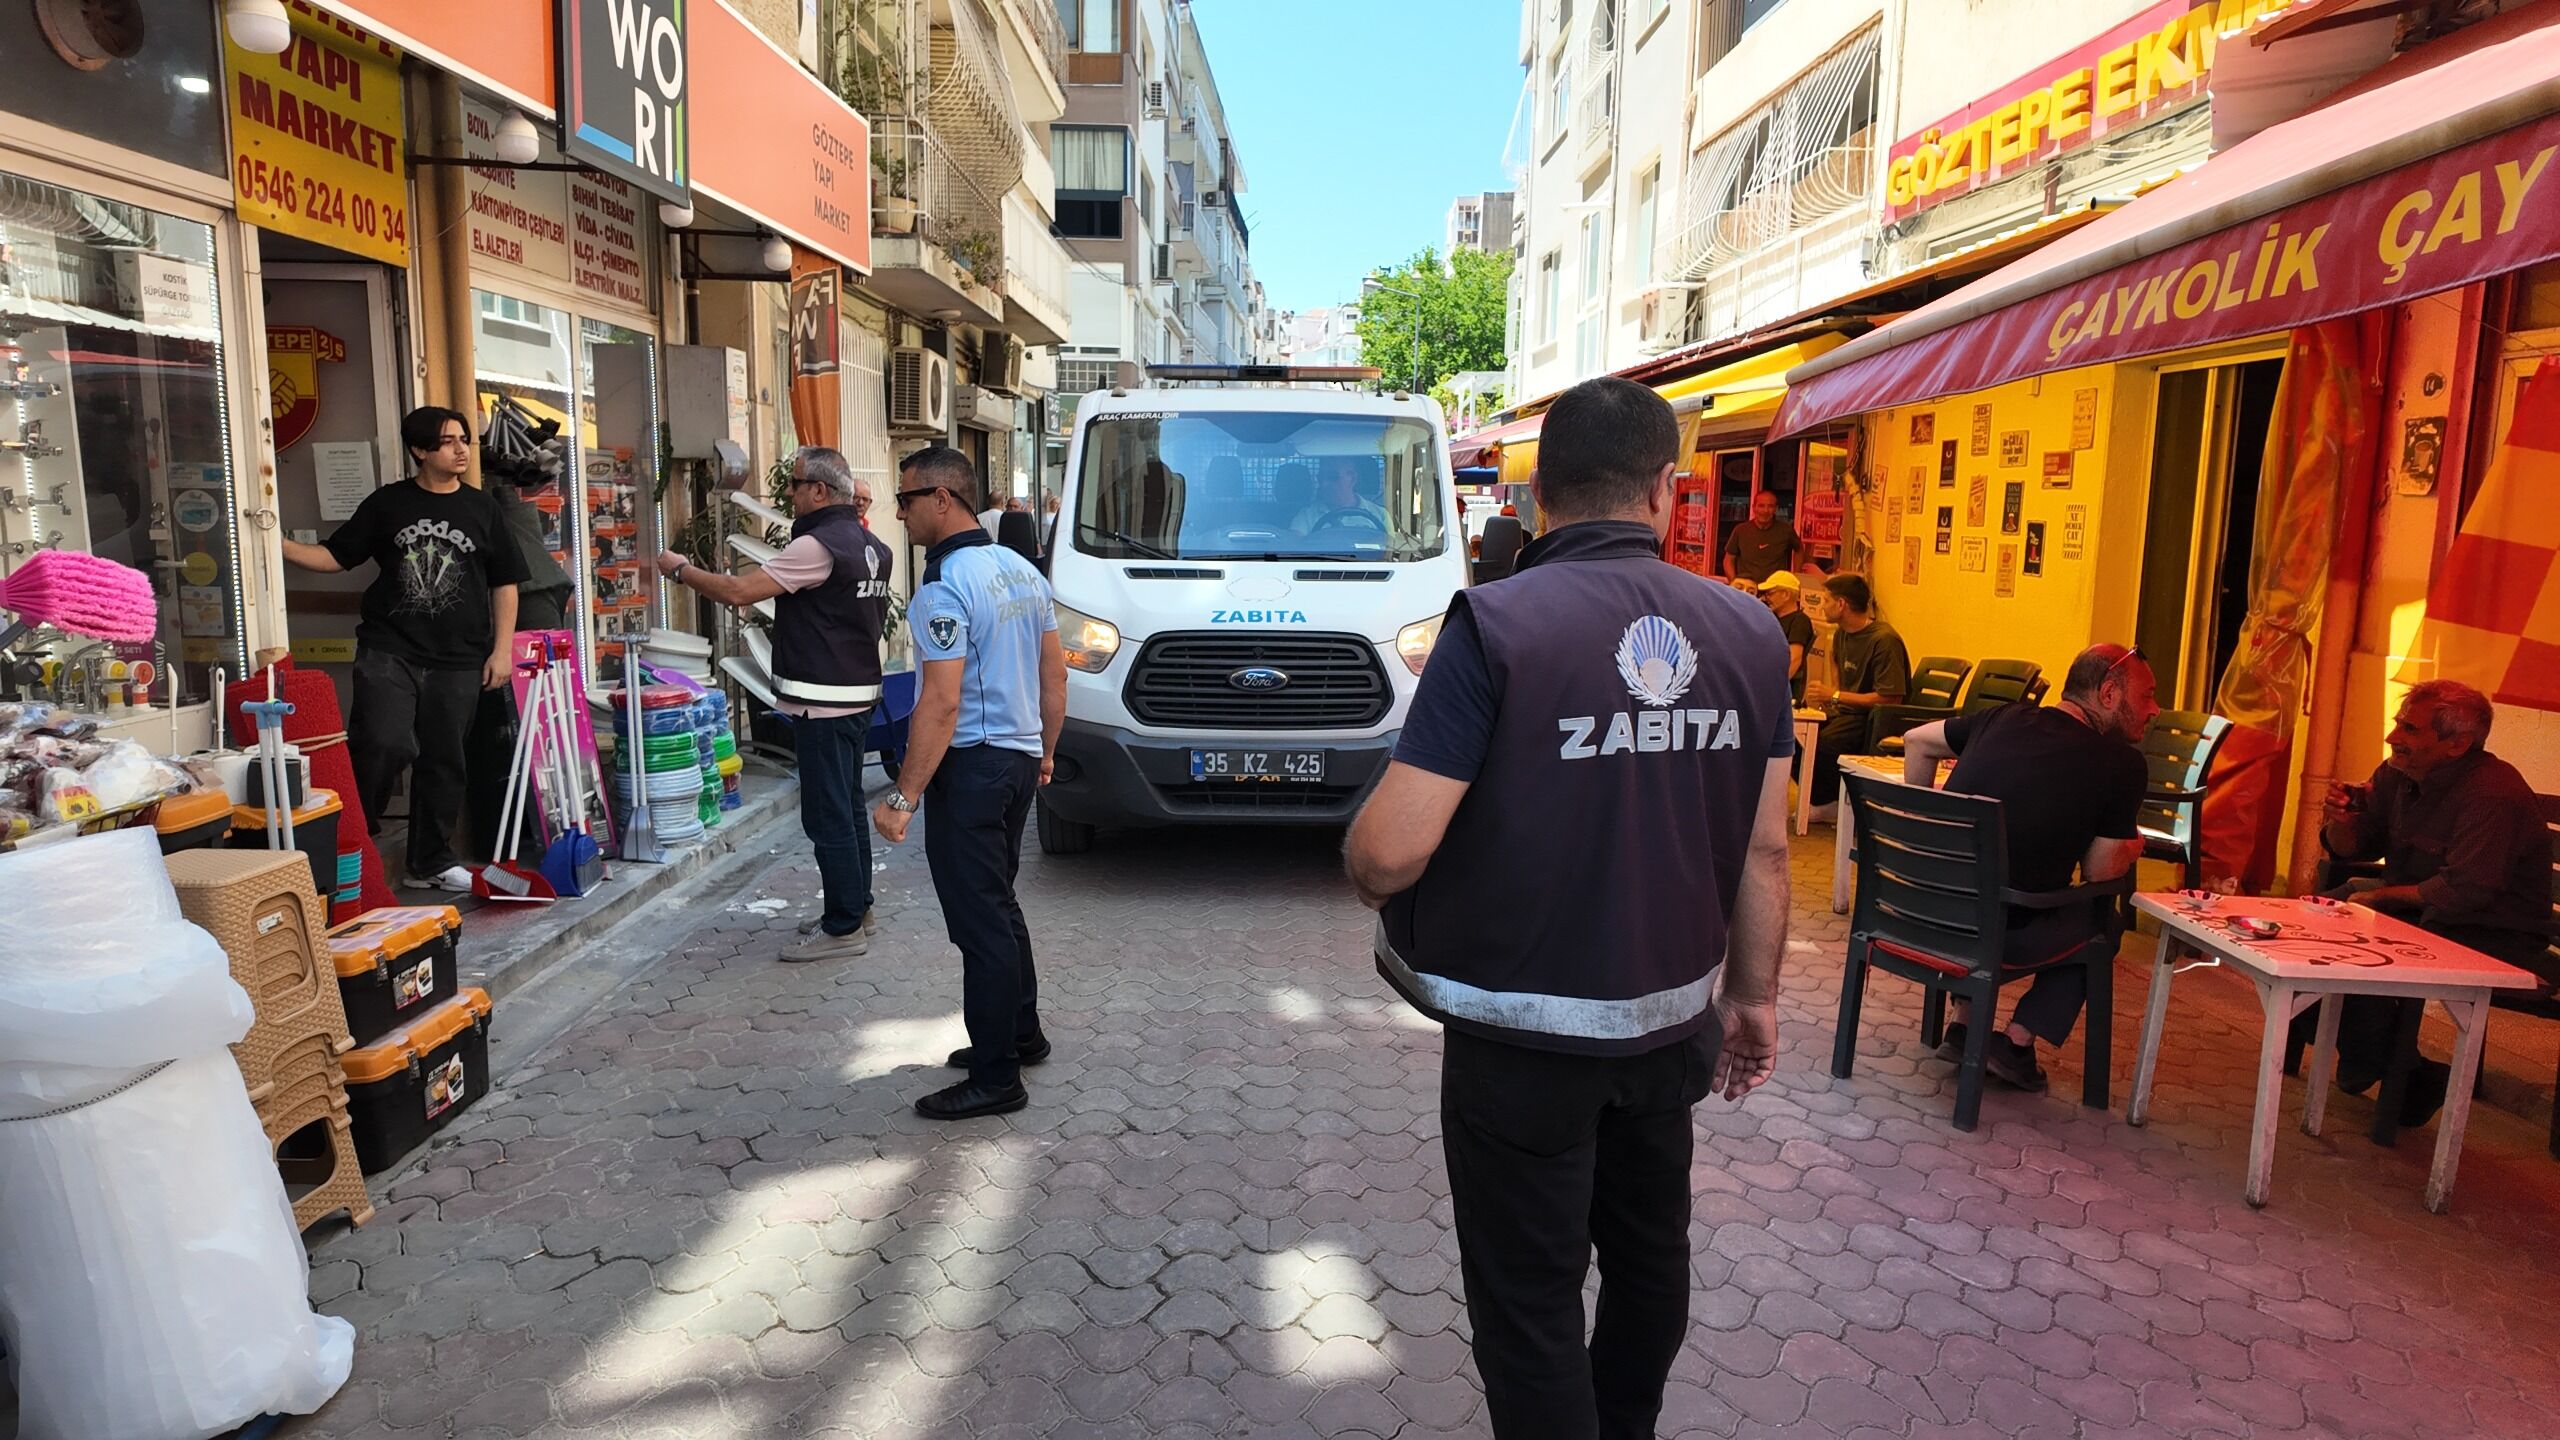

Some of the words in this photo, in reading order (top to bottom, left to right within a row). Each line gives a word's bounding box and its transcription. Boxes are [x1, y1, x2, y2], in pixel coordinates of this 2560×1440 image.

[279, 32, 361, 103] YAPI
[238, 71, 396, 174] MARKET
[467, 112, 490, 142] BOYA
[1887, 67, 2093, 207] GÖZTEPE
[812, 122, 854, 171] GÖZTEPE
[812, 158, 834, 192] YAPI
[238, 154, 297, 213] 0546
[303, 178, 346, 228] 224
[352, 193, 376, 237] 00
[382, 204, 406, 246] 34
[471, 190, 527, 231] KARTONPİYER
[529, 213, 565, 245] ÇEŞİTLERİ
[600, 195, 634, 226] TESİSAT
[814, 195, 851, 234] MARKET
[473, 228, 485, 252] EL
[486, 233, 523, 264] ALETLERİ
[575, 211, 598, 238] VİDA
[604, 222, 635, 252] CİVATA
[574, 239, 594, 265] ALÇI
[601, 247, 639, 278] ÇİMENTO
[2045, 222, 2332, 362] ÇAYKOLİK
[2377, 144, 2558, 285] ÇAY
[143, 285, 177, 300] SÜPÜRGE
[162, 273, 188, 285] KOSTİK
[268, 333, 312, 349] TEPE
[1097, 413, 1121, 421] ARAÇ
[986, 569, 1039, 598] KONAK
[1211, 609, 1307, 624] ZABITA
[1242, 672, 1274, 687] Ford
[1558, 709, 1741, 760] ZABITA
[1204, 752, 1228, 773] 35
[1244, 753, 1268, 773] KZ
[1284, 754, 1320, 773] 425
